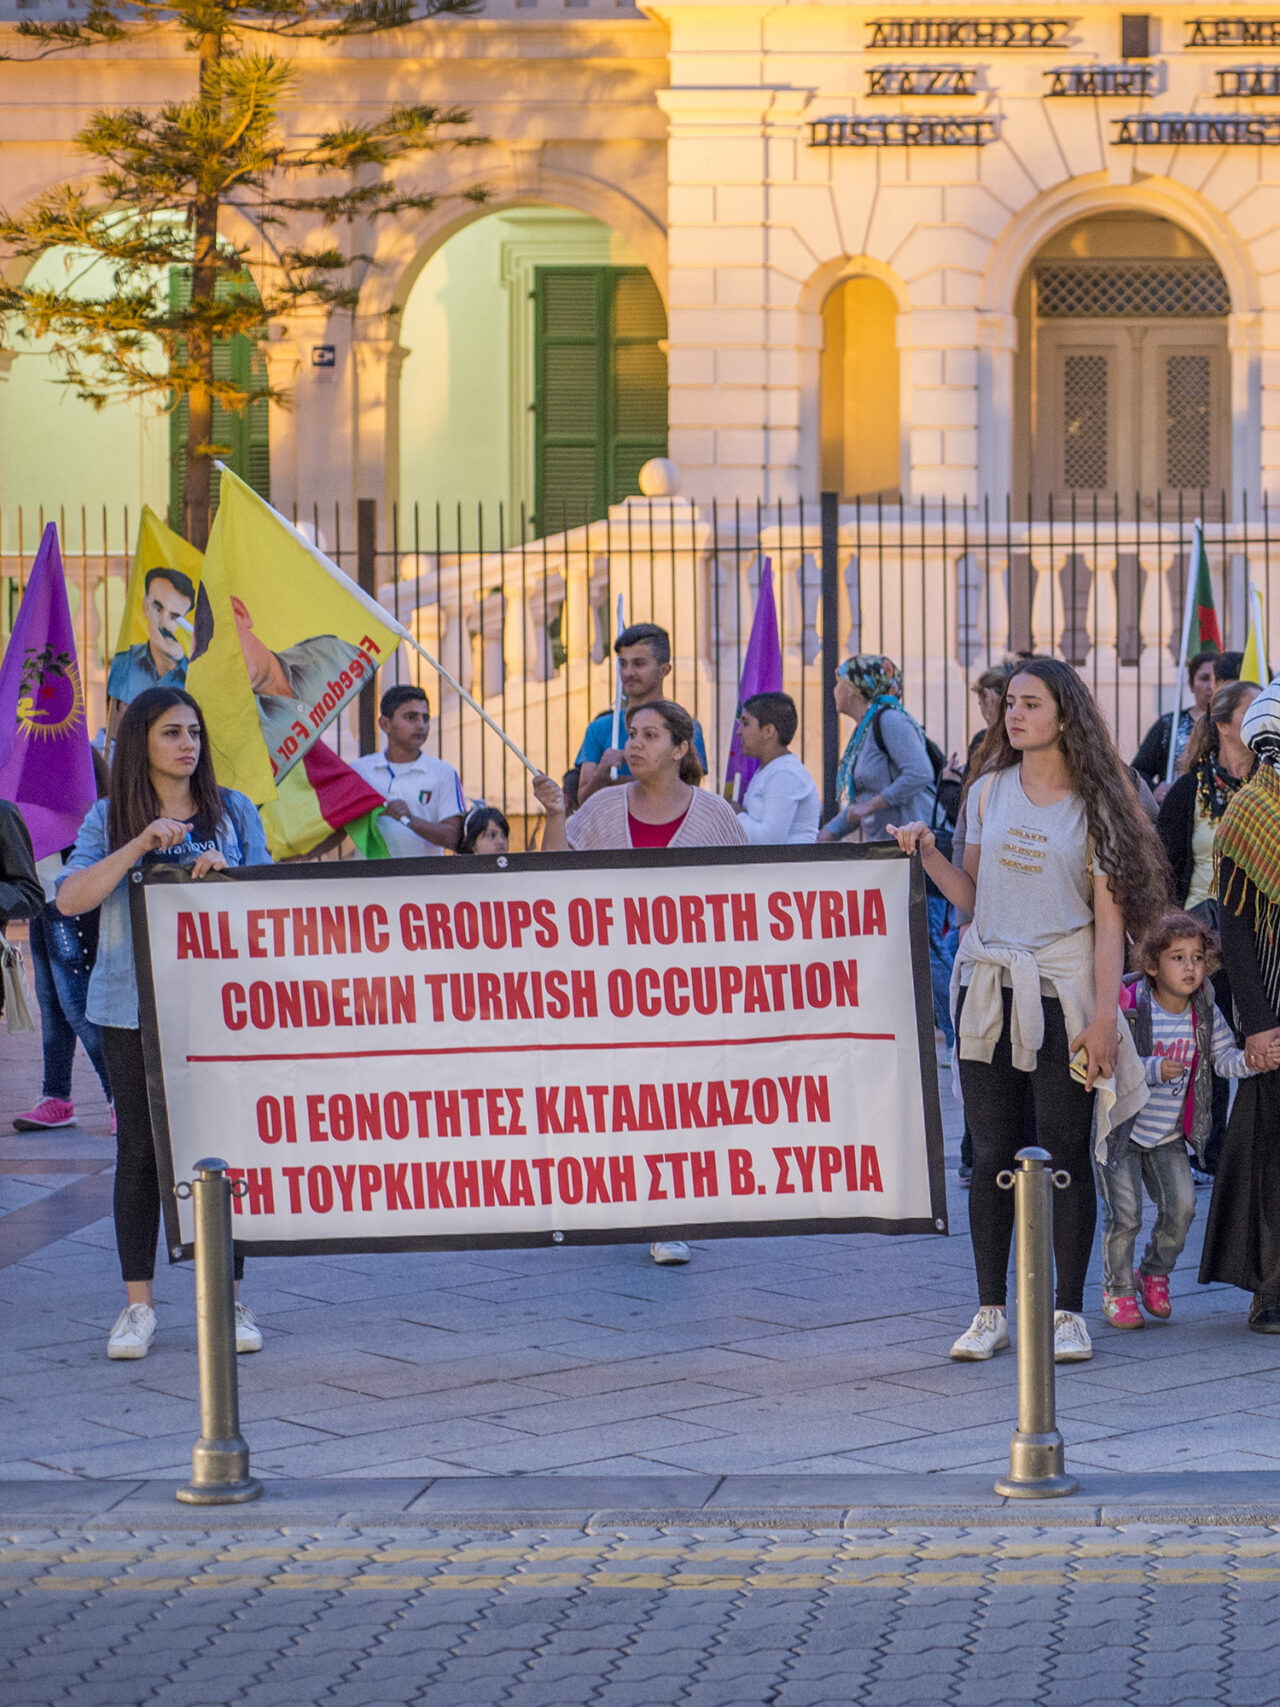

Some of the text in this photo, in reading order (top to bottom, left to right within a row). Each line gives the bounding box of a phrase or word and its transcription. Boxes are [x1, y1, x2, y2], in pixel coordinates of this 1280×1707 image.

[865, 70, 976, 97] KAZA
[806, 121, 992, 146] DISTRICT
[178, 889, 886, 959] ALL ETHNIC GROUPS OF NORTH SYRIA
[222, 960, 858, 1030] CONDEMN TURKISH OCCUPATION
[257, 1076, 830, 1143] ΟΙ ΕΘΝΟΤΗΤΕΣ ΚΑΤΑΔΙΚΑΖΟΥΝ
[645, 1151, 718, 1200] ΣΤΗ
[728, 1149, 765, 1195] Β.
[773, 1145, 883, 1194] ΣΥΡΙΑ
